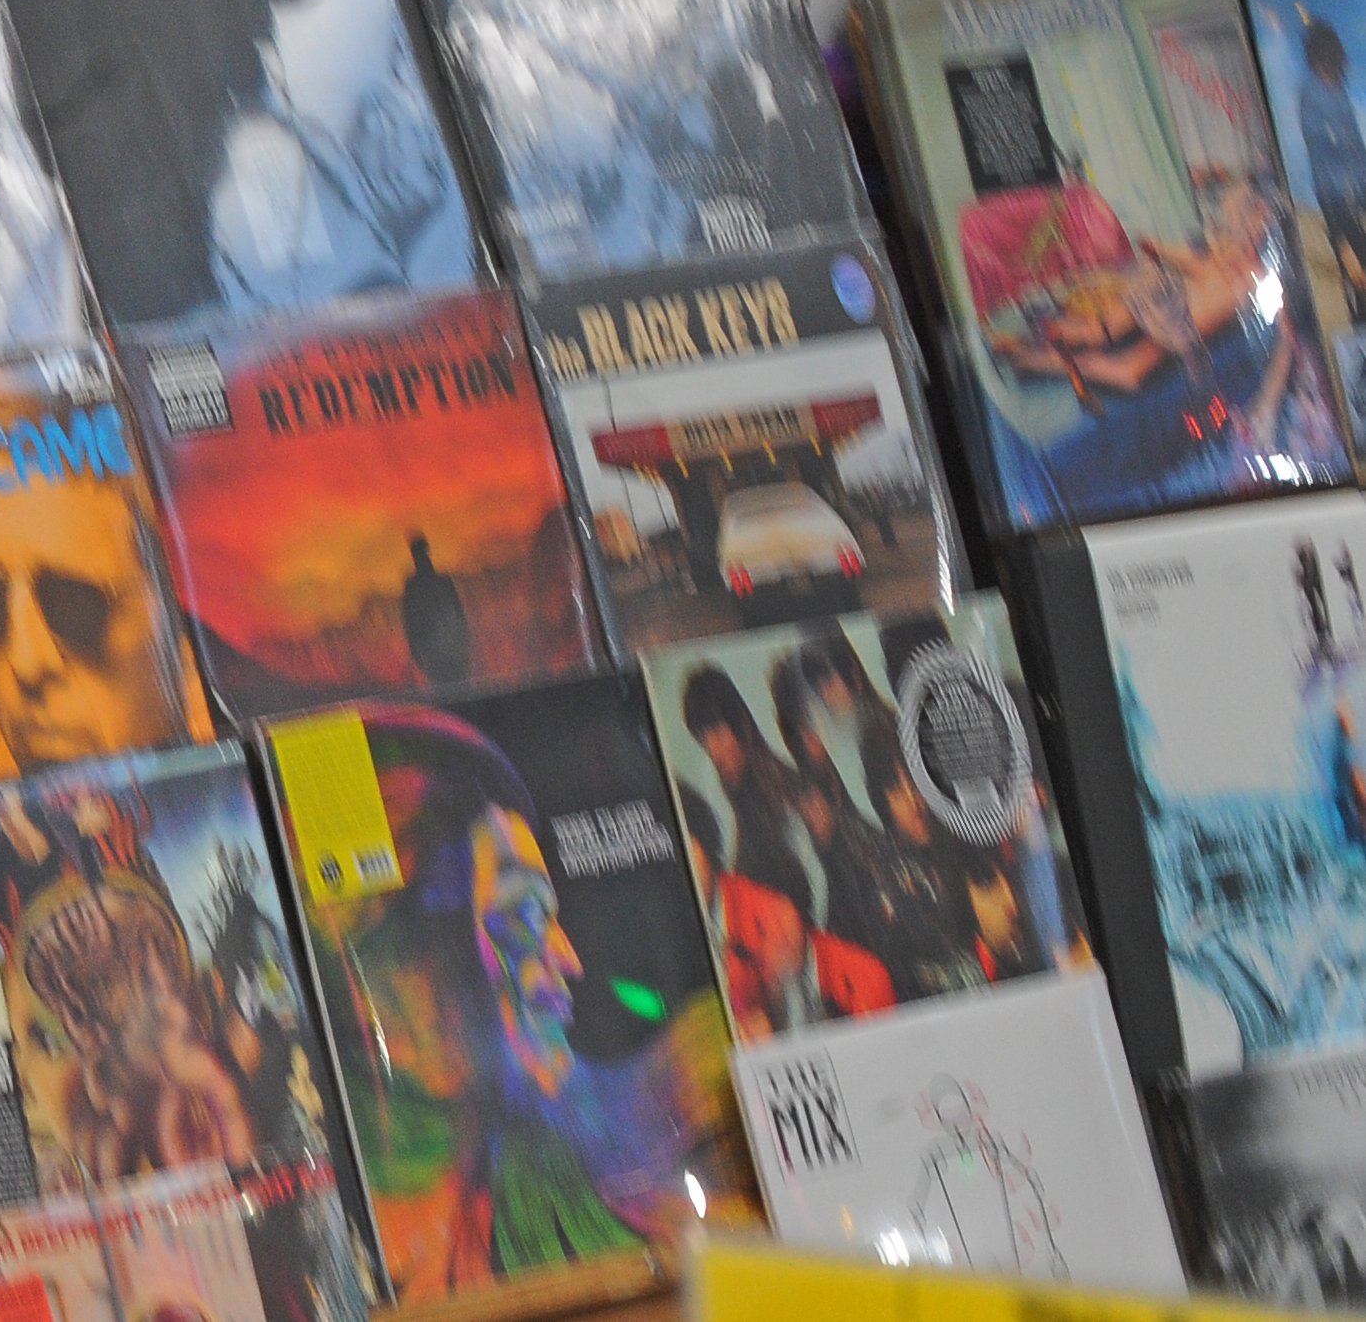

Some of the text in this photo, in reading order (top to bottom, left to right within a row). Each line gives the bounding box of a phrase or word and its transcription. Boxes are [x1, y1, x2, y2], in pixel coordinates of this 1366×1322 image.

[576, 292, 704, 376] BLACK
[694, 276, 801, 359] KEYS
[259, 352, 518, 437] REDEMPTION
[768, 1093, 855, 1176] MIX
